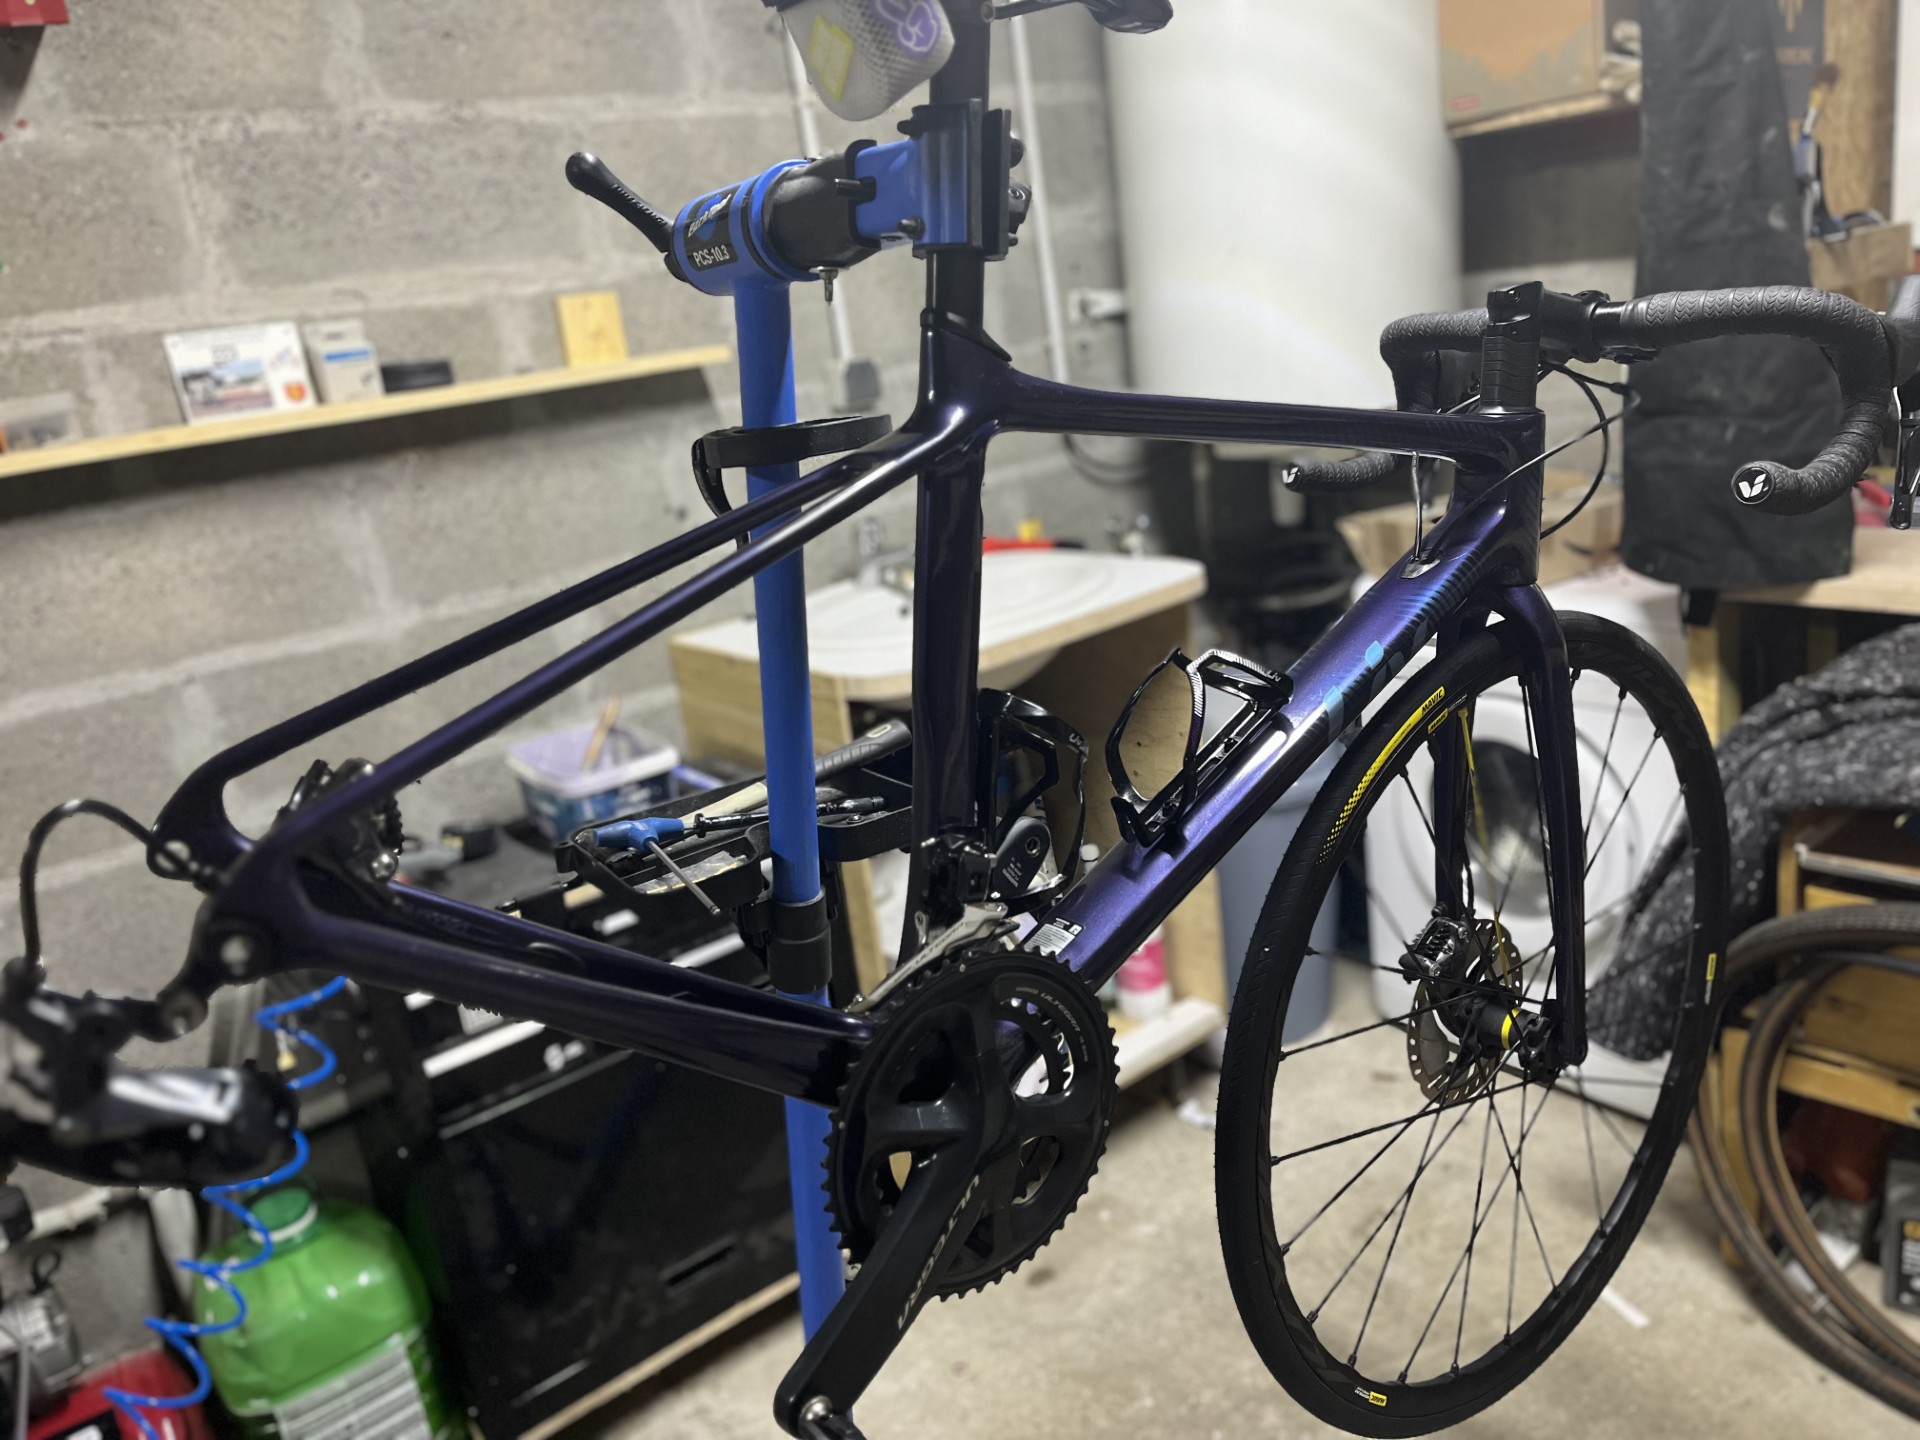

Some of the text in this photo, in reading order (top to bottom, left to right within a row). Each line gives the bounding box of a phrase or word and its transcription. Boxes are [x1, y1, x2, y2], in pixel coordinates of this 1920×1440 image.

[692, 244, 731, 268] PCS-10.3
[1421, 688, 1444, 716] MAVIC
[1040, 992, 1081, 1032] ULTEGRA
[897, 1174, 980, 1330] ULTEGRA
